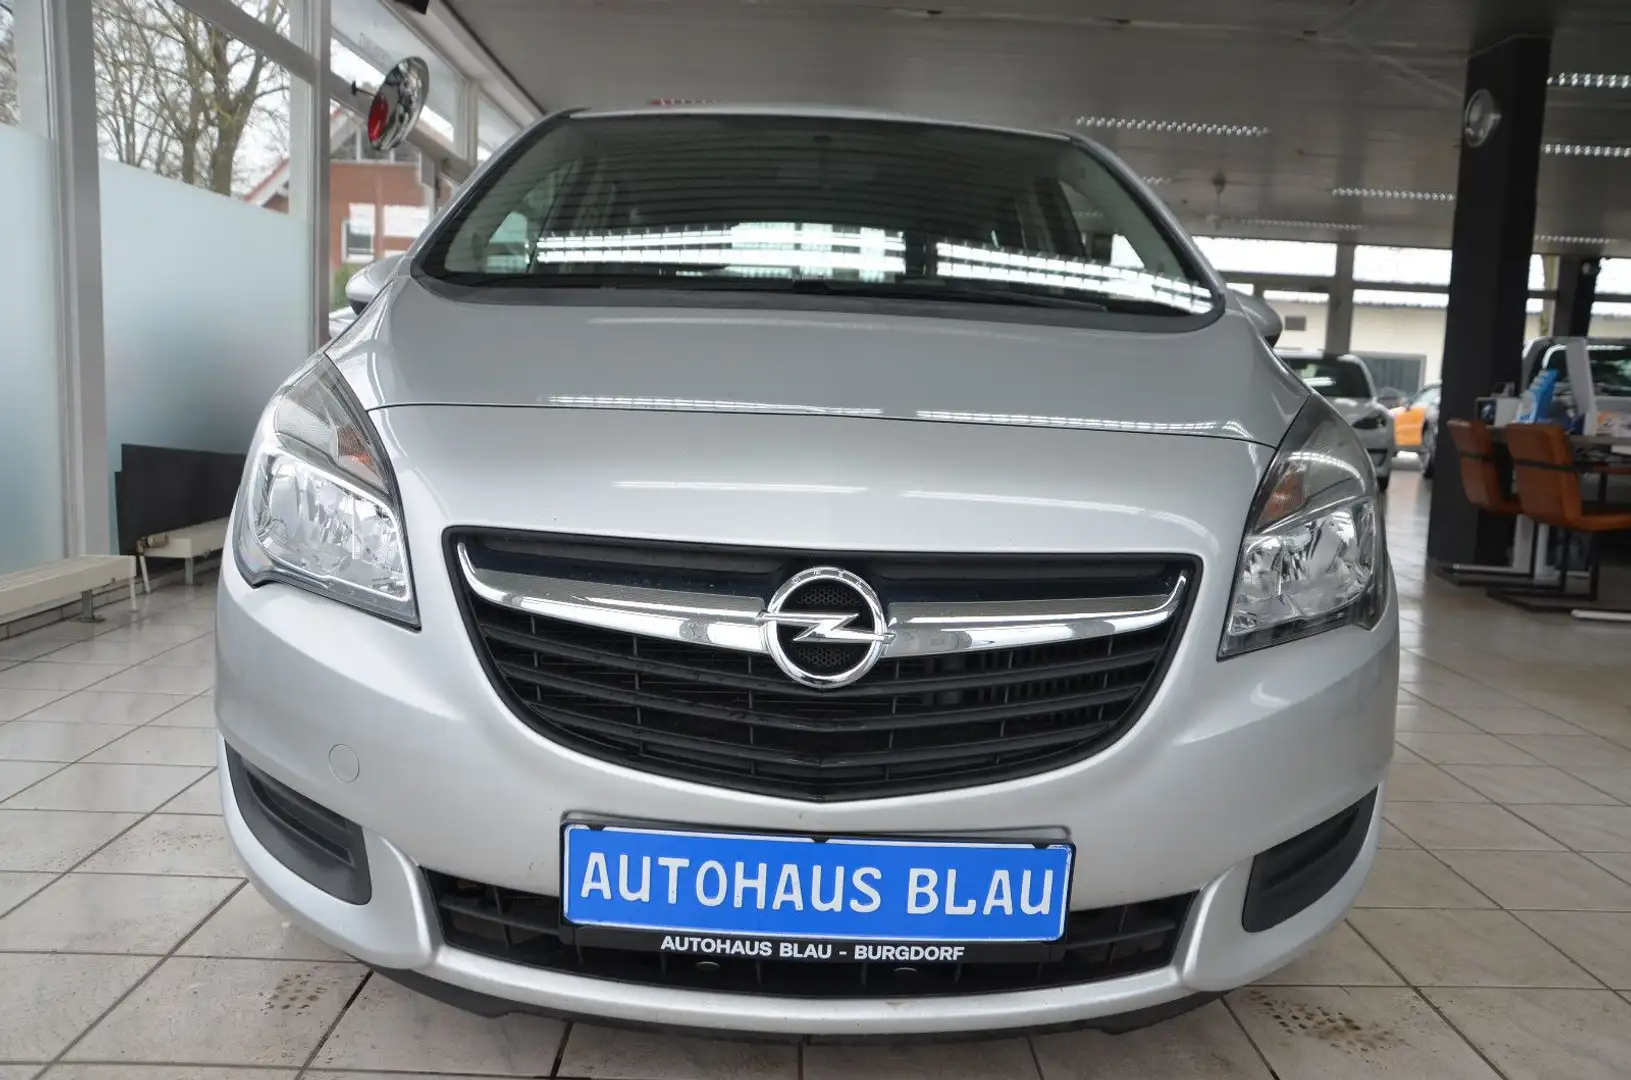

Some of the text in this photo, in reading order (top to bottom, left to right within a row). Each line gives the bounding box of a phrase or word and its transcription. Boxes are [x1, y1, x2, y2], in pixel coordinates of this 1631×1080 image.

[580, 851, 1054, 916] AUTOHAUS BLAU
[660, 935, 773, 957] AUTOHAUS
[779, 942, 832, 959] BLAU
[854, 944, 965, 961] BURGDORF
